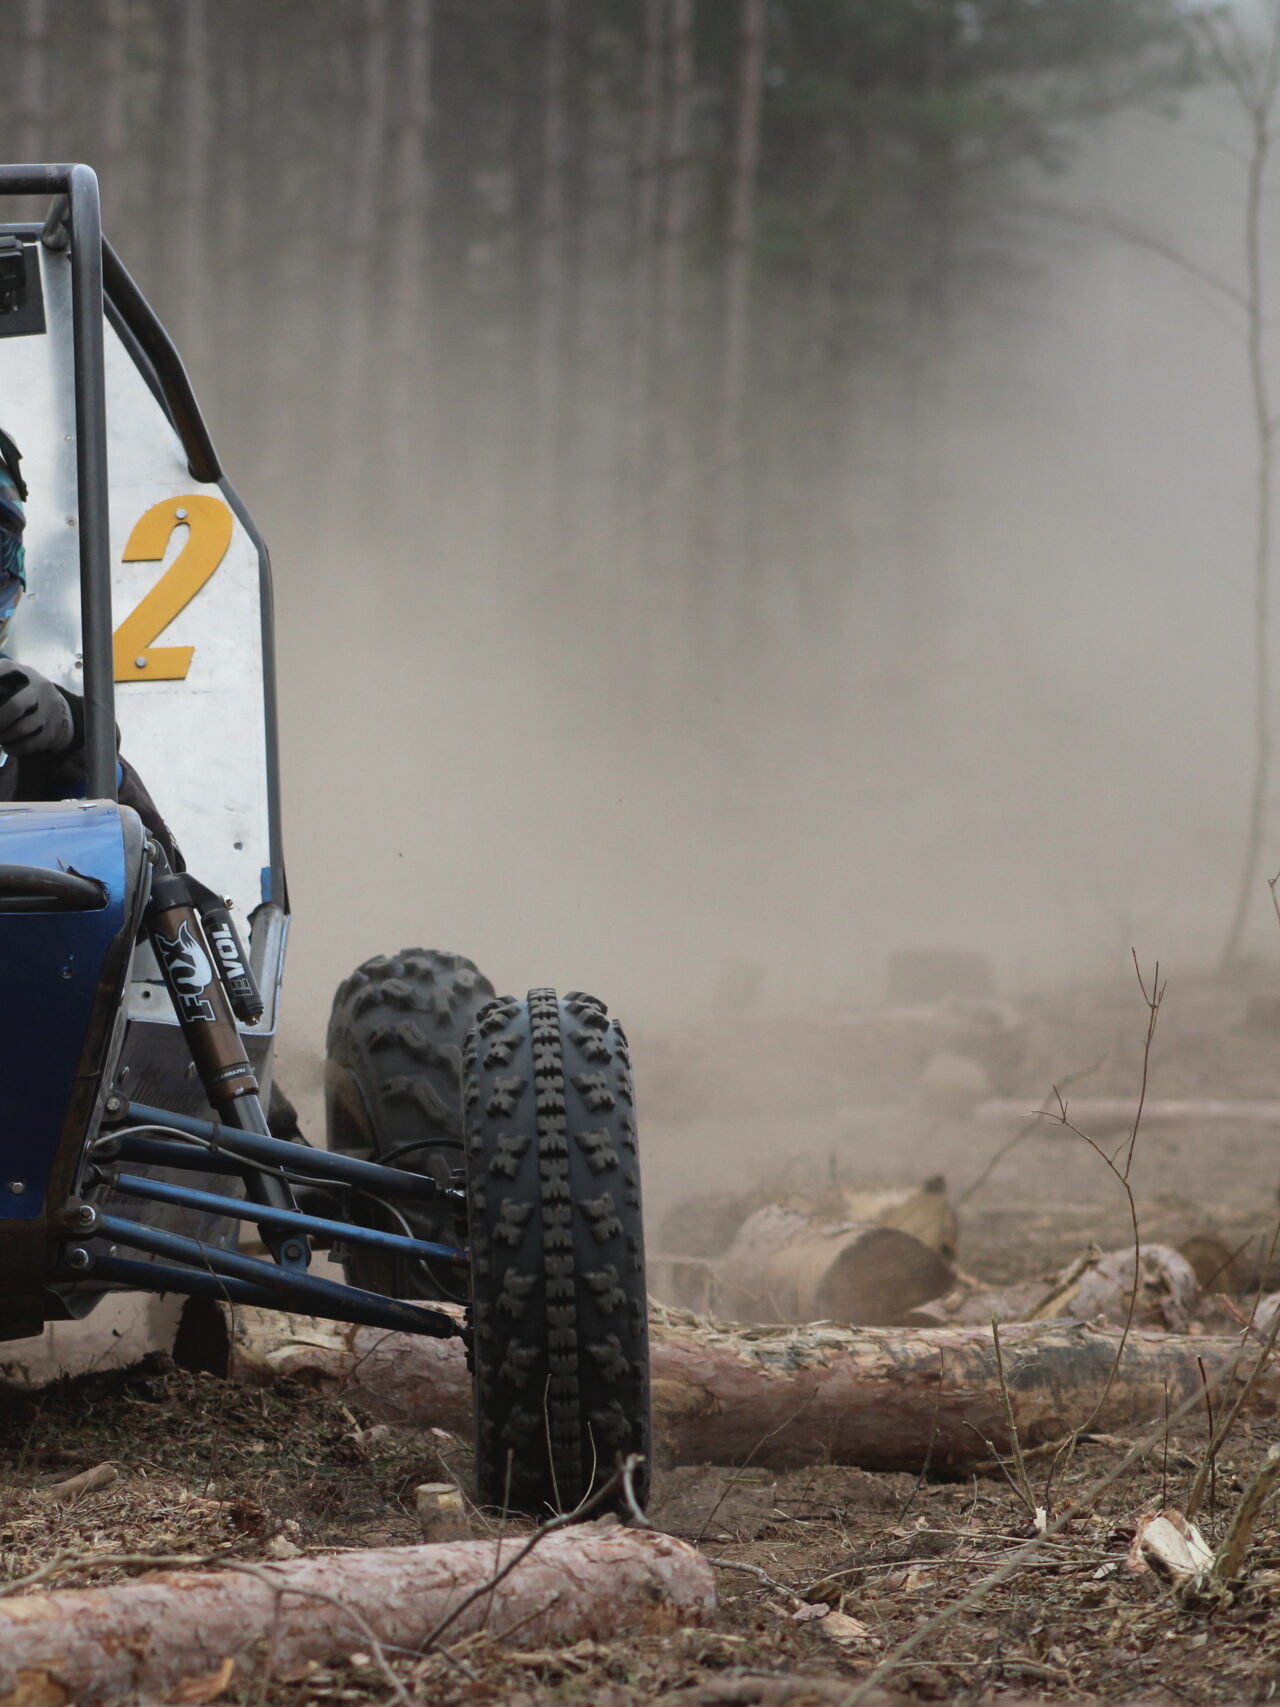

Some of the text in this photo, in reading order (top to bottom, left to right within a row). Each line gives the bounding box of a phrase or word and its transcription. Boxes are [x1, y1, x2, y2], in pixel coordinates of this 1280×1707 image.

[112, 494, 234, 683] 2
[154, 919, 216, 1022] FOX
[212, 923, 253, 996] EVOL
